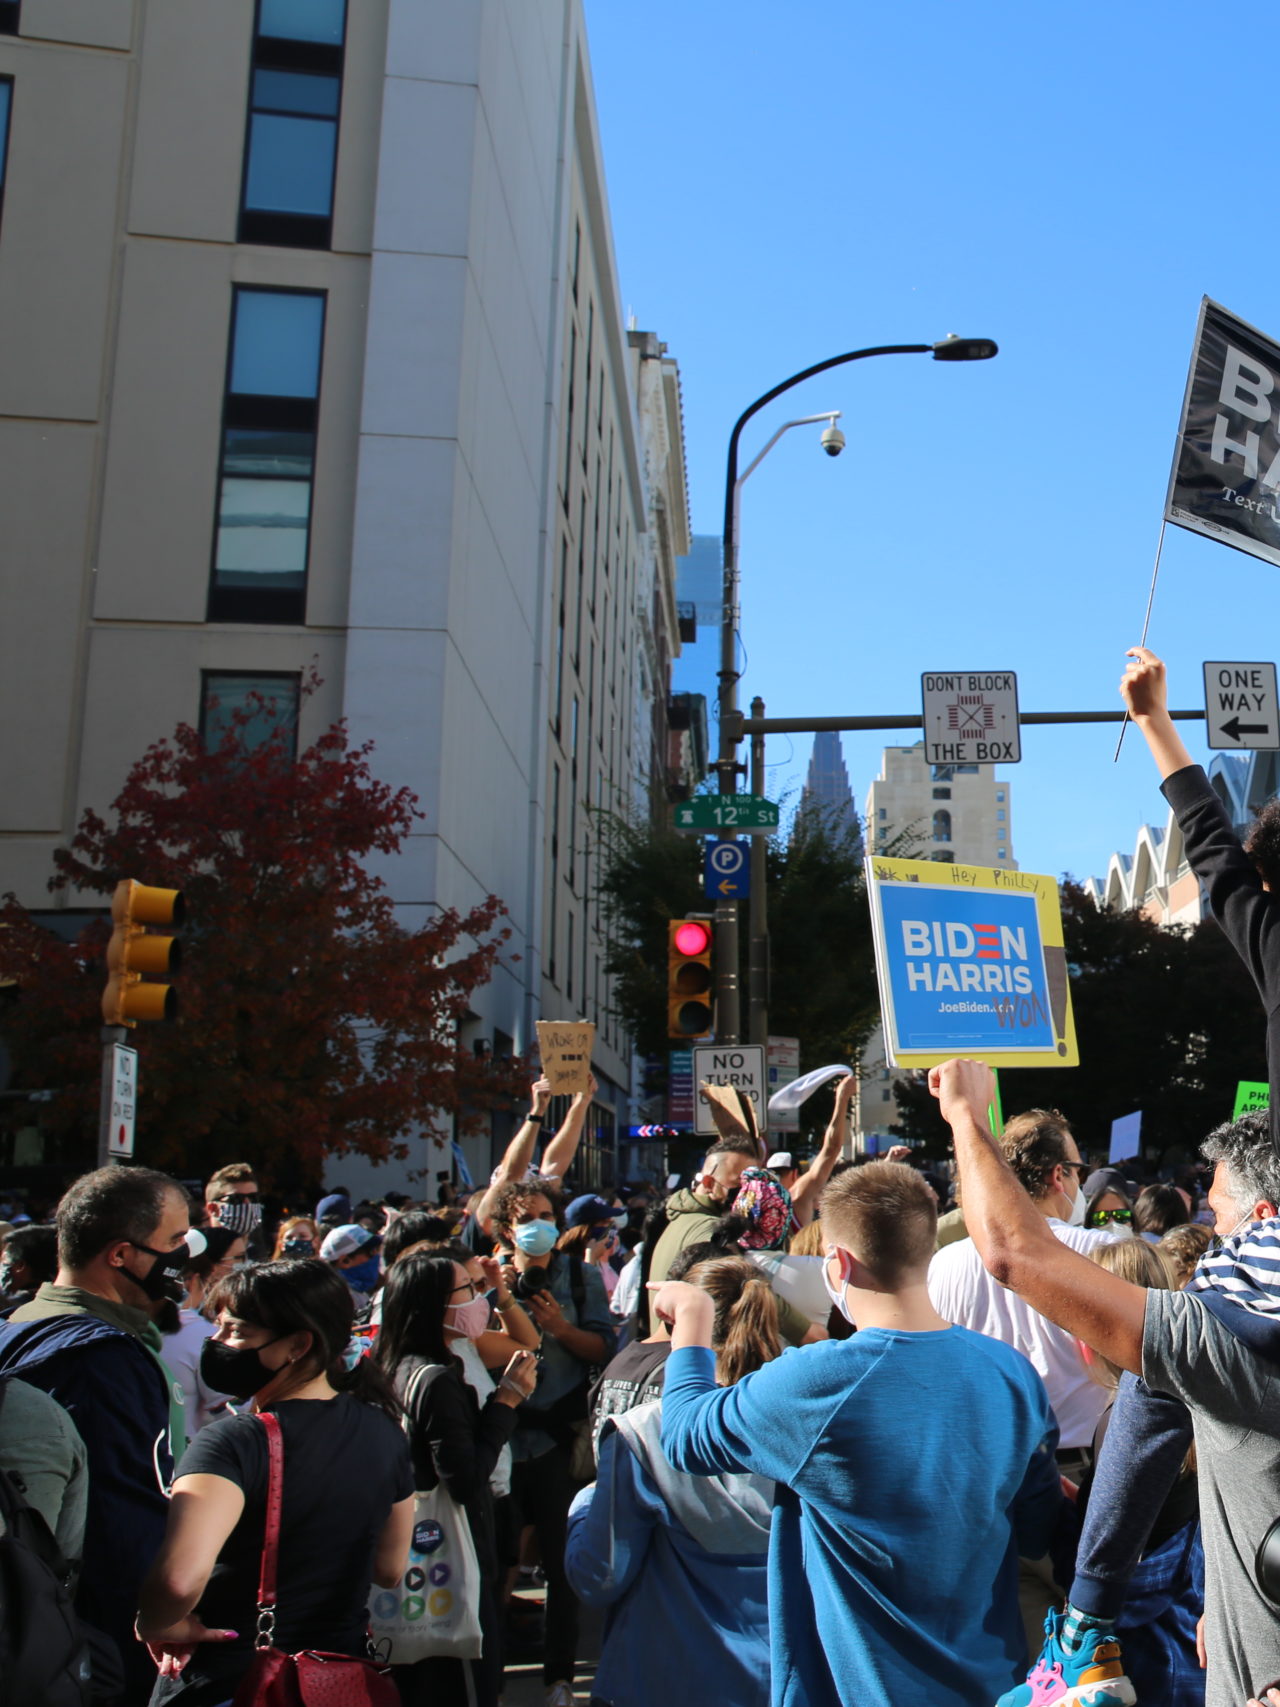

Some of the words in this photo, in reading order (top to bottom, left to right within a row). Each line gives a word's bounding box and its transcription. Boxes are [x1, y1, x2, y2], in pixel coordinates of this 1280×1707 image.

[1221, 486, 1275, 516] Text
[968, 675, 1012, 691] BLOCK
[1219, 669, 1263, 688] ONE
[1219, 692, 1266, 712] WAY
[932, 743, 967, 760] THE
[976, 742, 1014, 760] BOX
[721, 796, 731, 805] N
[713, 807, 750, 825] 12th
[757, 810, 775, 823] St
[721, 851, 733, 866] P
[952, 867, 977, 886] Hey
[901, 919, 1028, 960] BIDEN
[906, 962, 1033, 994] HARRIS
[713, 1053, 744, 1069] NO
[706, 1073, 753, 1087] TURN
